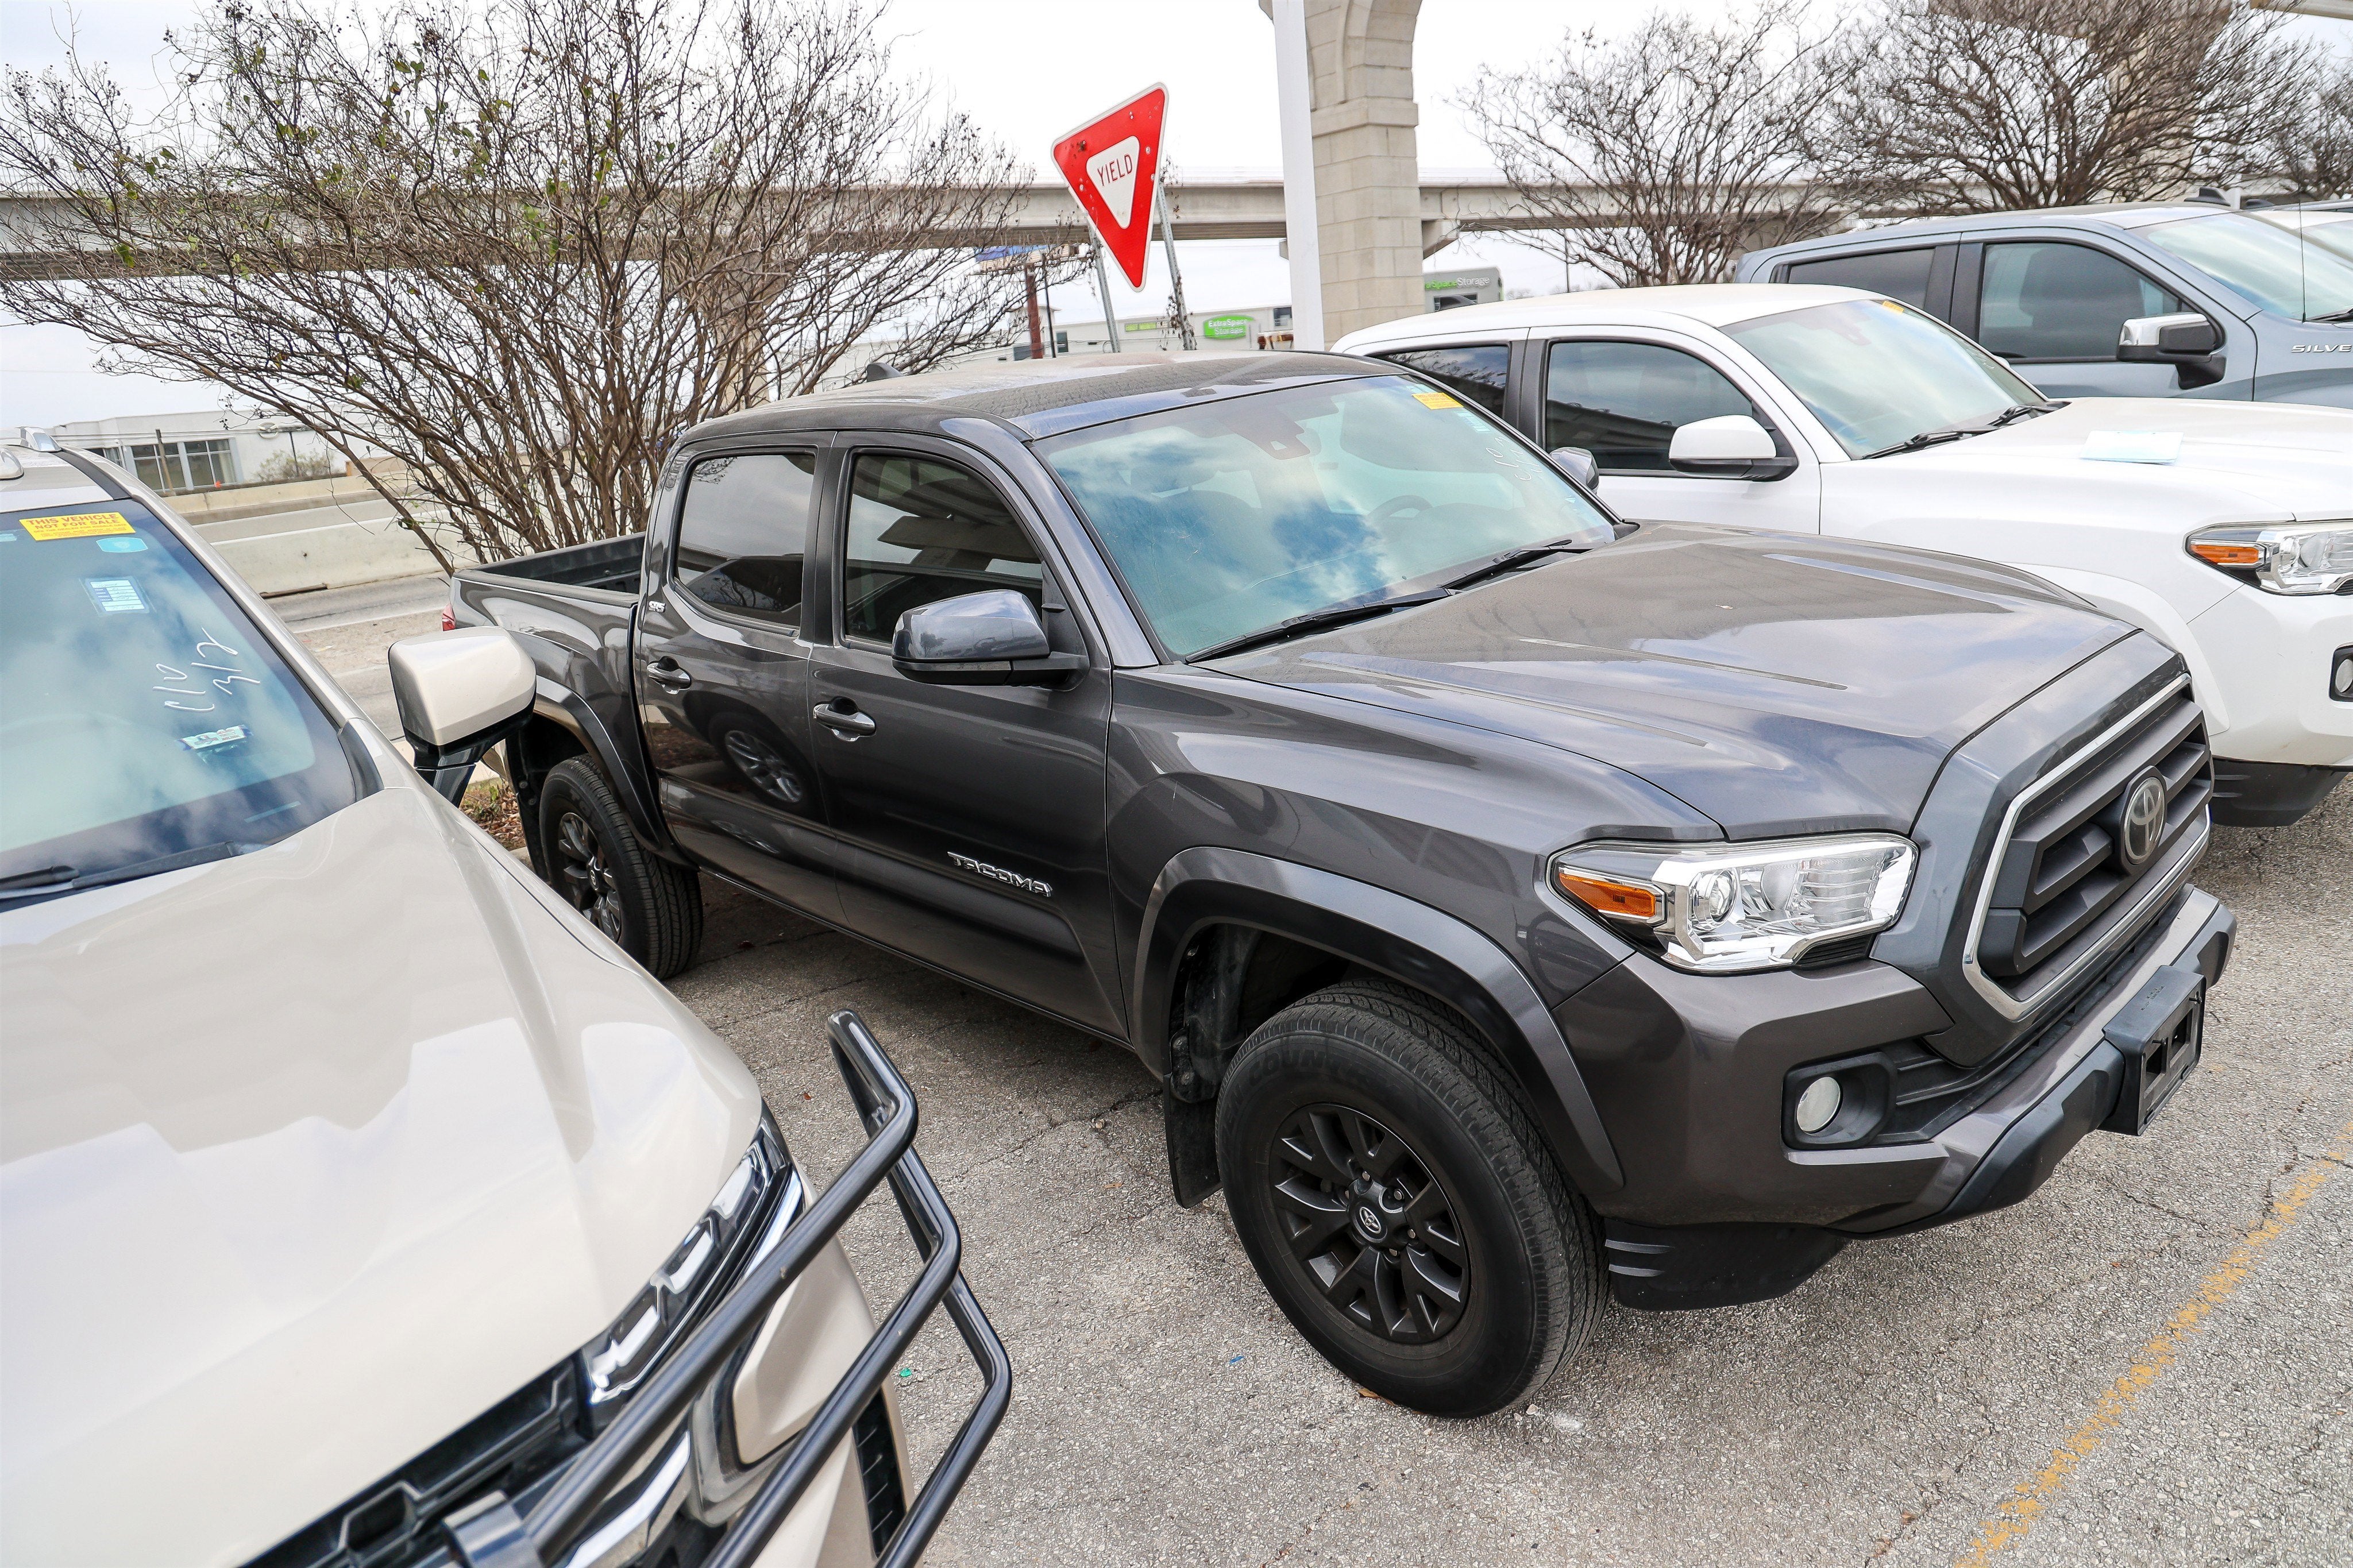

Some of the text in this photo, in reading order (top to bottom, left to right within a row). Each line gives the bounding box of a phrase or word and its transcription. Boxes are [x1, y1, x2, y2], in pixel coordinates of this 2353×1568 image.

[1097, 153, 1133, 187] YIELD
[2291, 344, 2353, 353] SILVE
[26, 514, 119, 526] THIS VEHICLE
[649, 600, 665, 613] SR5
[947, 851, 1053, 898] TACOMA
